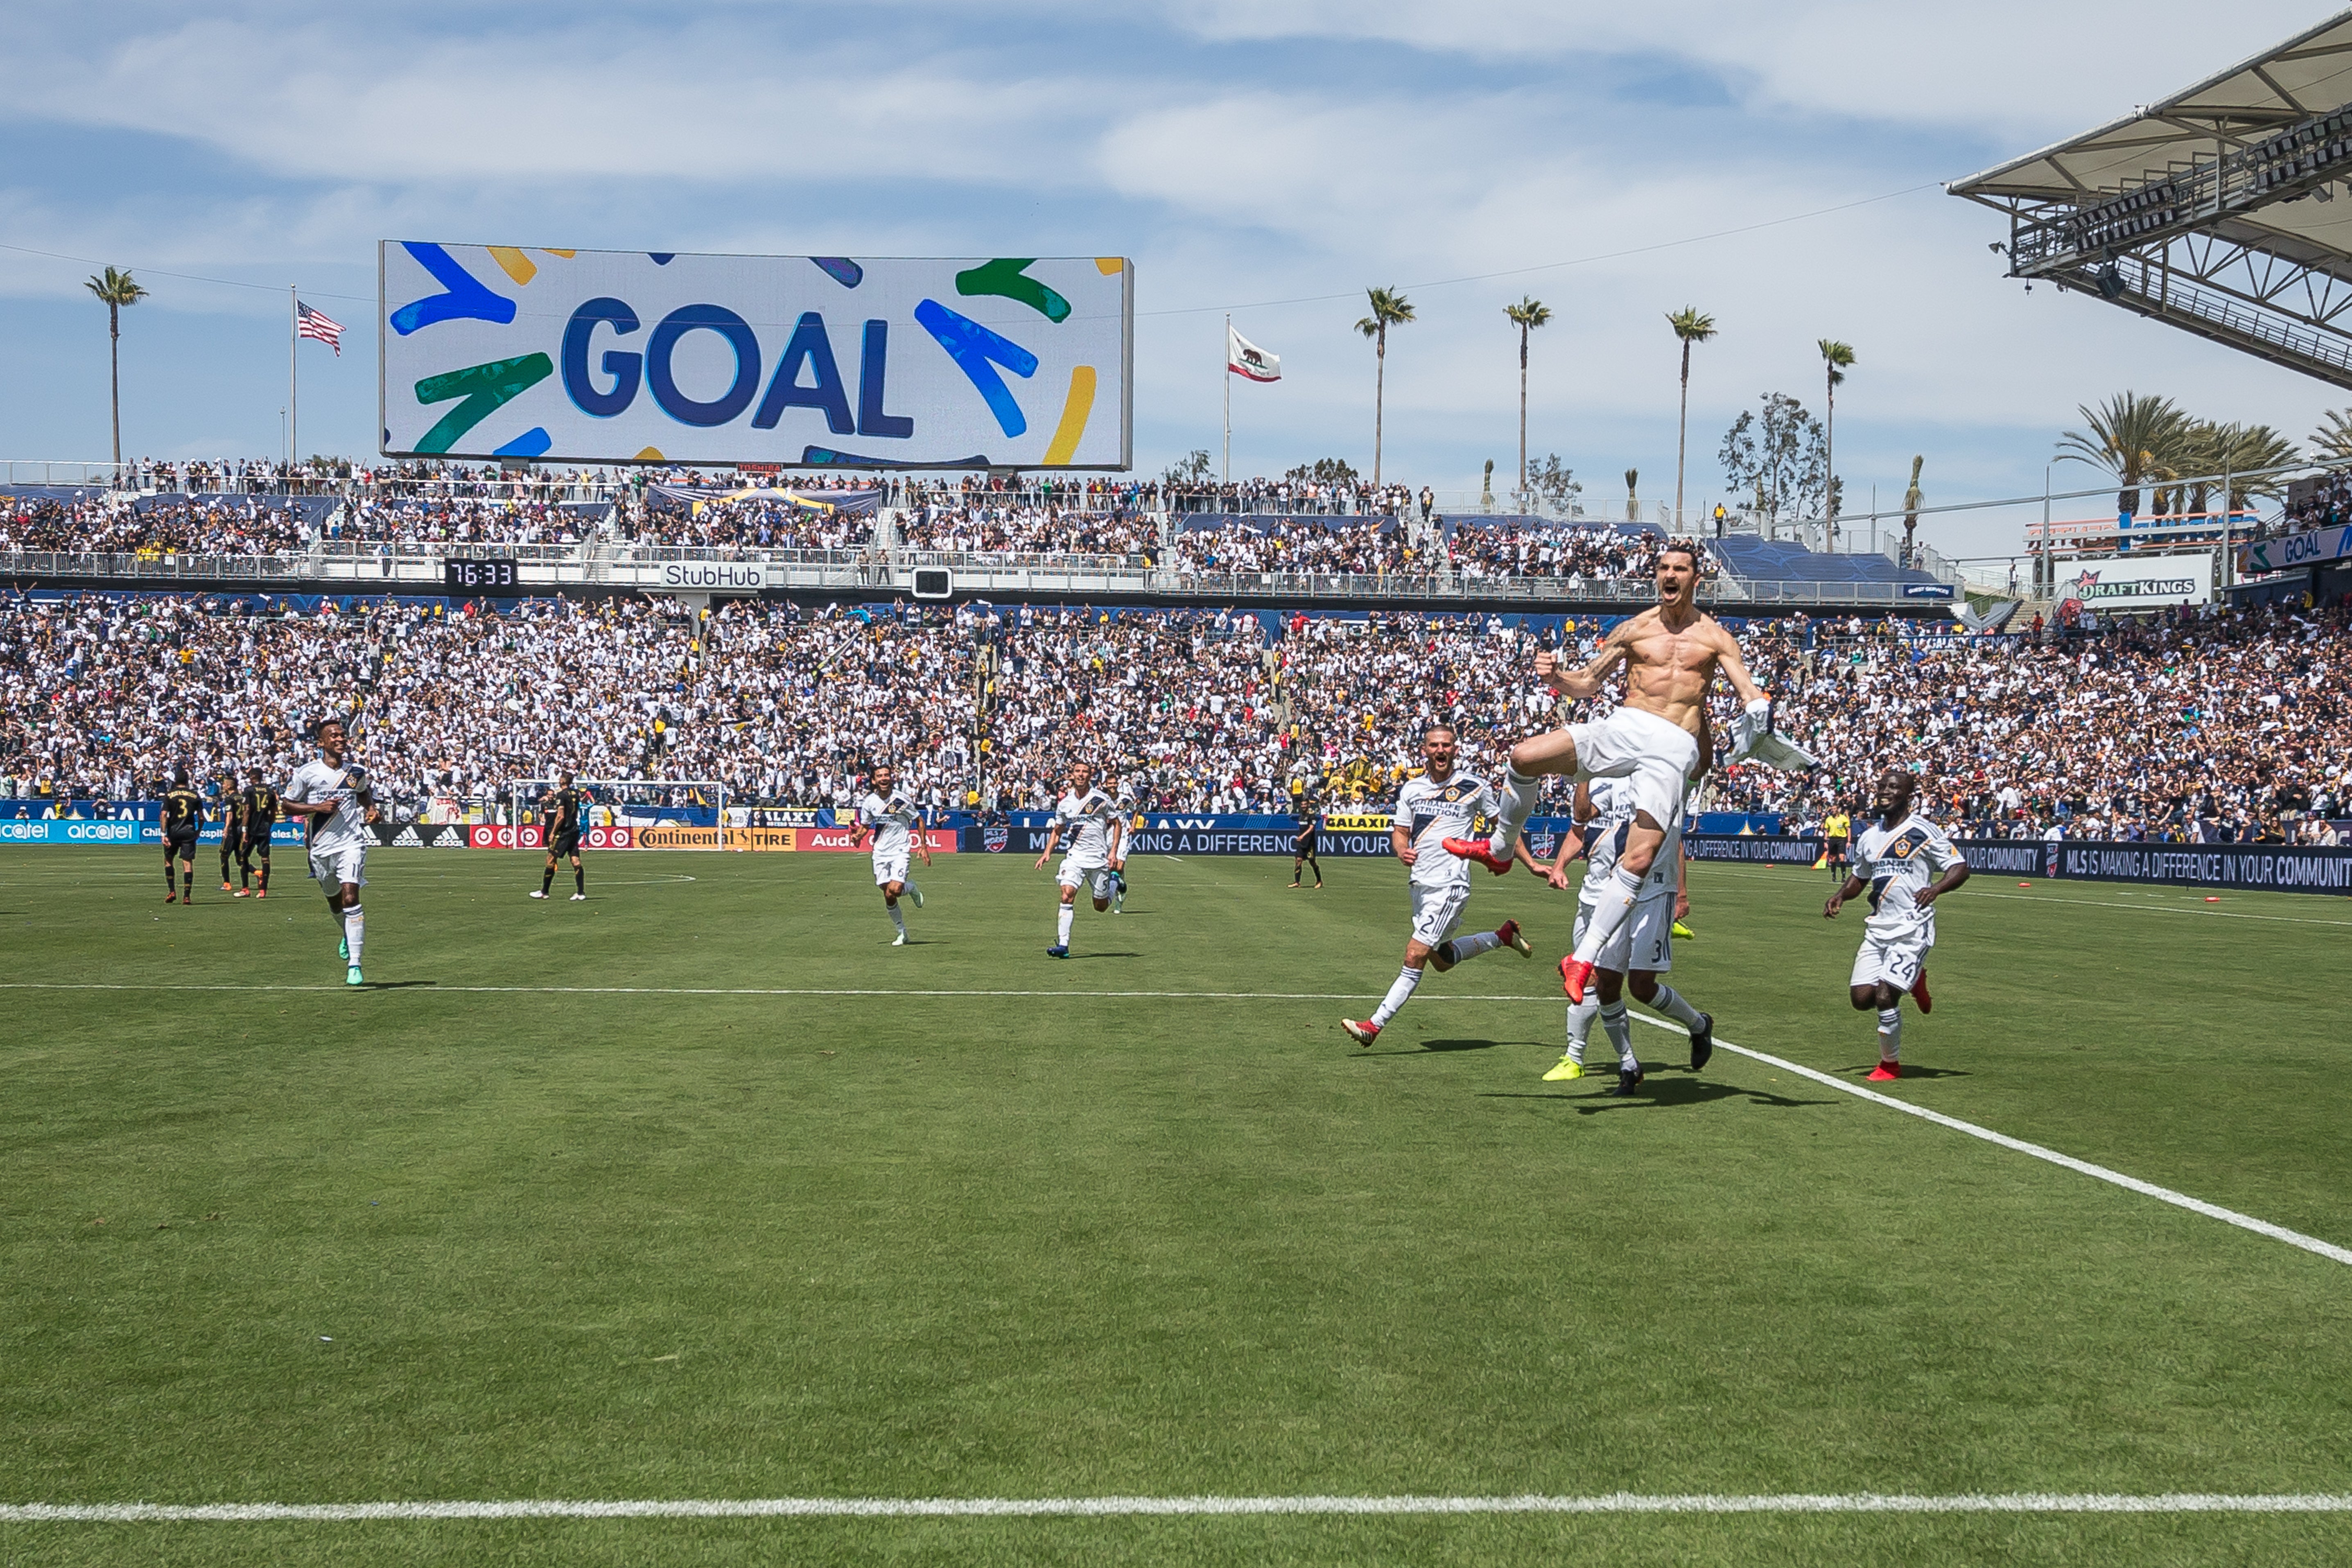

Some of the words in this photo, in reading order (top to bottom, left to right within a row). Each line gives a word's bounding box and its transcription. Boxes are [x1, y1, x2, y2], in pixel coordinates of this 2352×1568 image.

[561, 297, 914, 438] GOAL
[739, 463, 780, 472] TOSHIBA
[2285, 531, 2321, 563] GOAL
[451, 564, 511, 585] 76:33
[666, 565, 760, 586] StubHub
[177, 798, 188, 818] 3
[0, 823, 48, 839] catel
[67, 823, 132, 840] alcatel
[639, 828, 734, 848] Continental
[754, 834, 791, 846] TIRE
[1129, 834, 1173, 851] KING
[1178, 834, 1192, 851] A
[1197, 834, 1299, 852] DIFFERENC
[1317, 835, 1335, 853] IN
[1340, 836, 1390, 853] YOUR
[1693, 841, 1698, 856] A
[1699, 840, 1740, 858] DIFFERENCE
[1741, 841, 1749, 858] IN
[1749, 841, 1769, 859] YOUR
[1770, 842, 1817, 861] COMMUNITY
[1845, 843, 1855, 862] ML
[1966, 847, 1986, 869] YOUR
[1987, 847, 2038, 872] COMMUNITY
[2066, 850, 2087, 874] MLS
[2089, 850, 2099, 874] IS
[2100, 851, 2140, 877] MAKING
[2141, 852, 2149, 877] A
[2152, 852, 2221, 881] DIFFERENCE
[2223, 854, 2236, 881] IN
[2239, 855, 2273, 884] YOUR
[2276, 856, 2352, 887] COMMUNIT
[898, 868, 904, 877] 6
[1102, 879, 1108, 891] 5
[1420, 914, 1435, 934] 2
[1651, 939, 1662, 964] 3
[1889, 953, 1915, 981] 24
